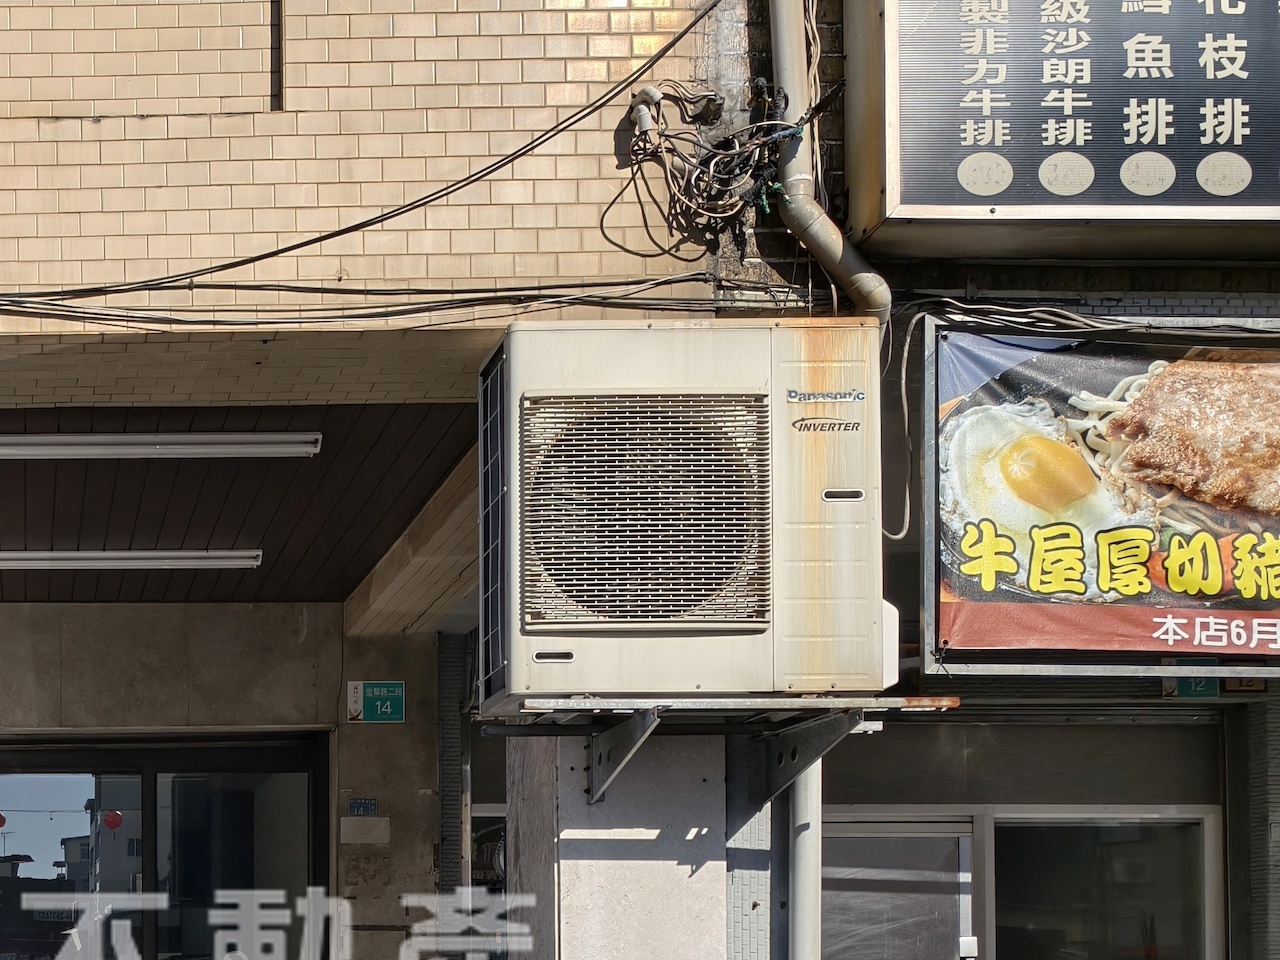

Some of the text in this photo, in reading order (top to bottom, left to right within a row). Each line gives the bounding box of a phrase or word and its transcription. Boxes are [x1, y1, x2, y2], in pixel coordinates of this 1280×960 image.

[787, 389, 866, 402] Panasonic
[798, 422, 861, 432] INVERTER
[1152, 613, 1280, 649] 本店6月
[1188, 678, 1206, 691] 12
[375, 700, 392, 715] 14
